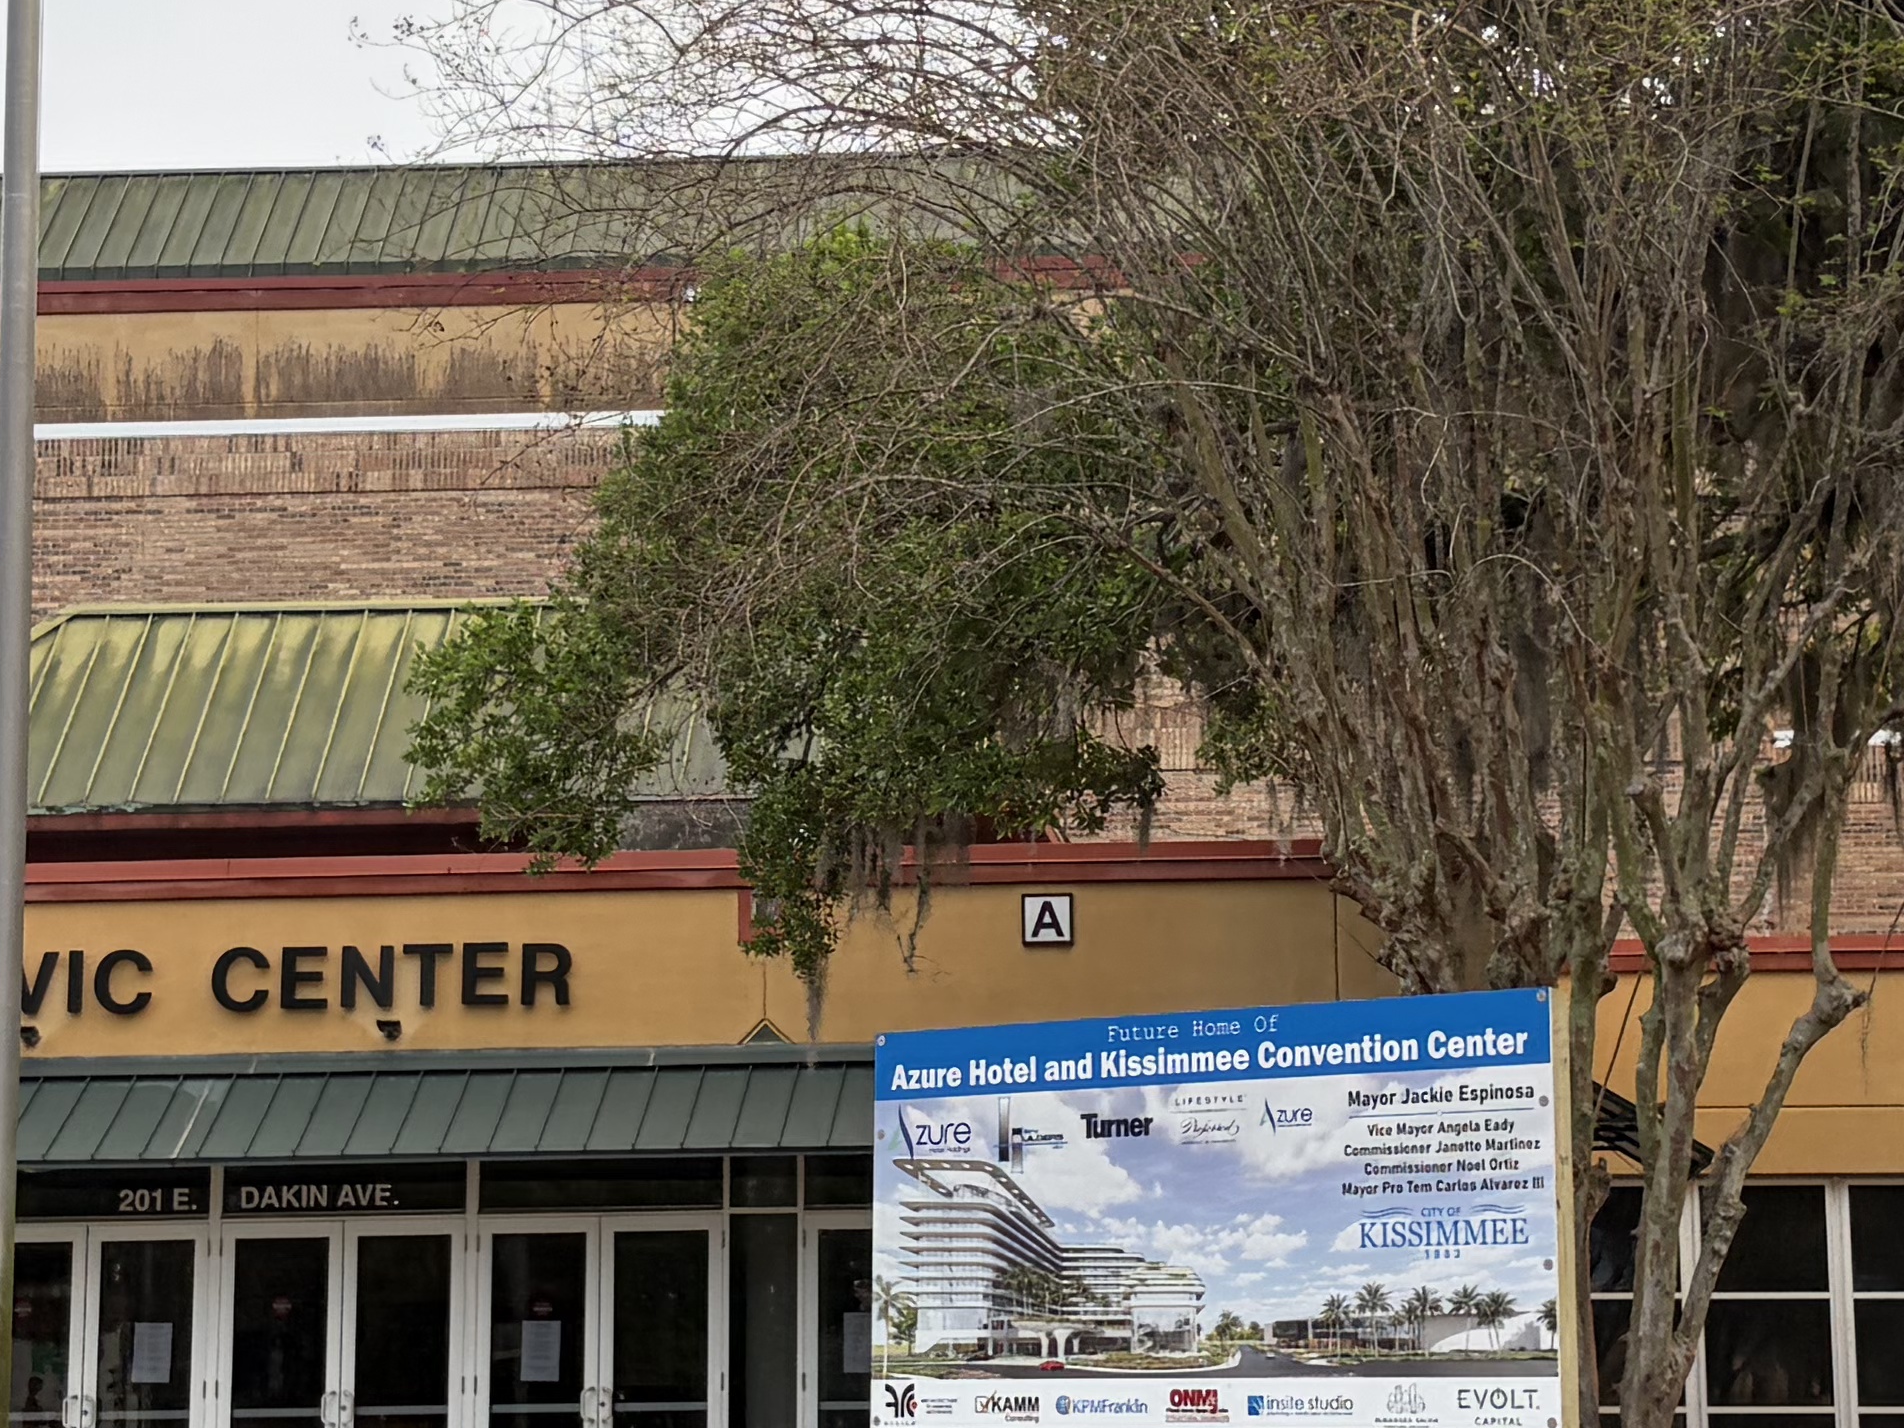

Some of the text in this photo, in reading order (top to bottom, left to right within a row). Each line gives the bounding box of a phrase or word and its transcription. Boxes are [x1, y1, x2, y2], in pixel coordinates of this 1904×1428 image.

[1031, 900, 1065, 938] A
[211, 942, 573, 1014] CENTER
[1107, 1013, 1280, 1043] Future Home Of
[891, 1027, 1529, 1091] Azure Hotel and Kissimmee Convention Center
[1347, 1083, 1535, 1110] Mayor Jackie Espinosa
[1079, 1112, 1154, 1139] Turner
[1367, 1123, 1392, 1137] Vice
[1396, 1122, 1434, 1138] Mayor
[1437, 1120, 1481, 1137] Angela
[1343, 1142, 1432, 1157] Commissioner
[1485, 1137, 1542, 1152] Martinez
[1364, 1157, 1520, 1177] Commissioner Noel Ortiz
[117, 1183, 400, 1213] 201 E. DAKIN AVE.
[1341, 1175, 1546, 1199] Mayor Pro Tem Carlos Alvarez III
[1421, 1206, 1462, 1218] CITY OF
[1358, 1217, 1530, 1249] KISSIMMEE
[991, 1395, 1040, 1413] KAMM
[1266, 1394, 1354, 1411] insite studio
[1474, 1416, 1523, 1427] CAPITAL
